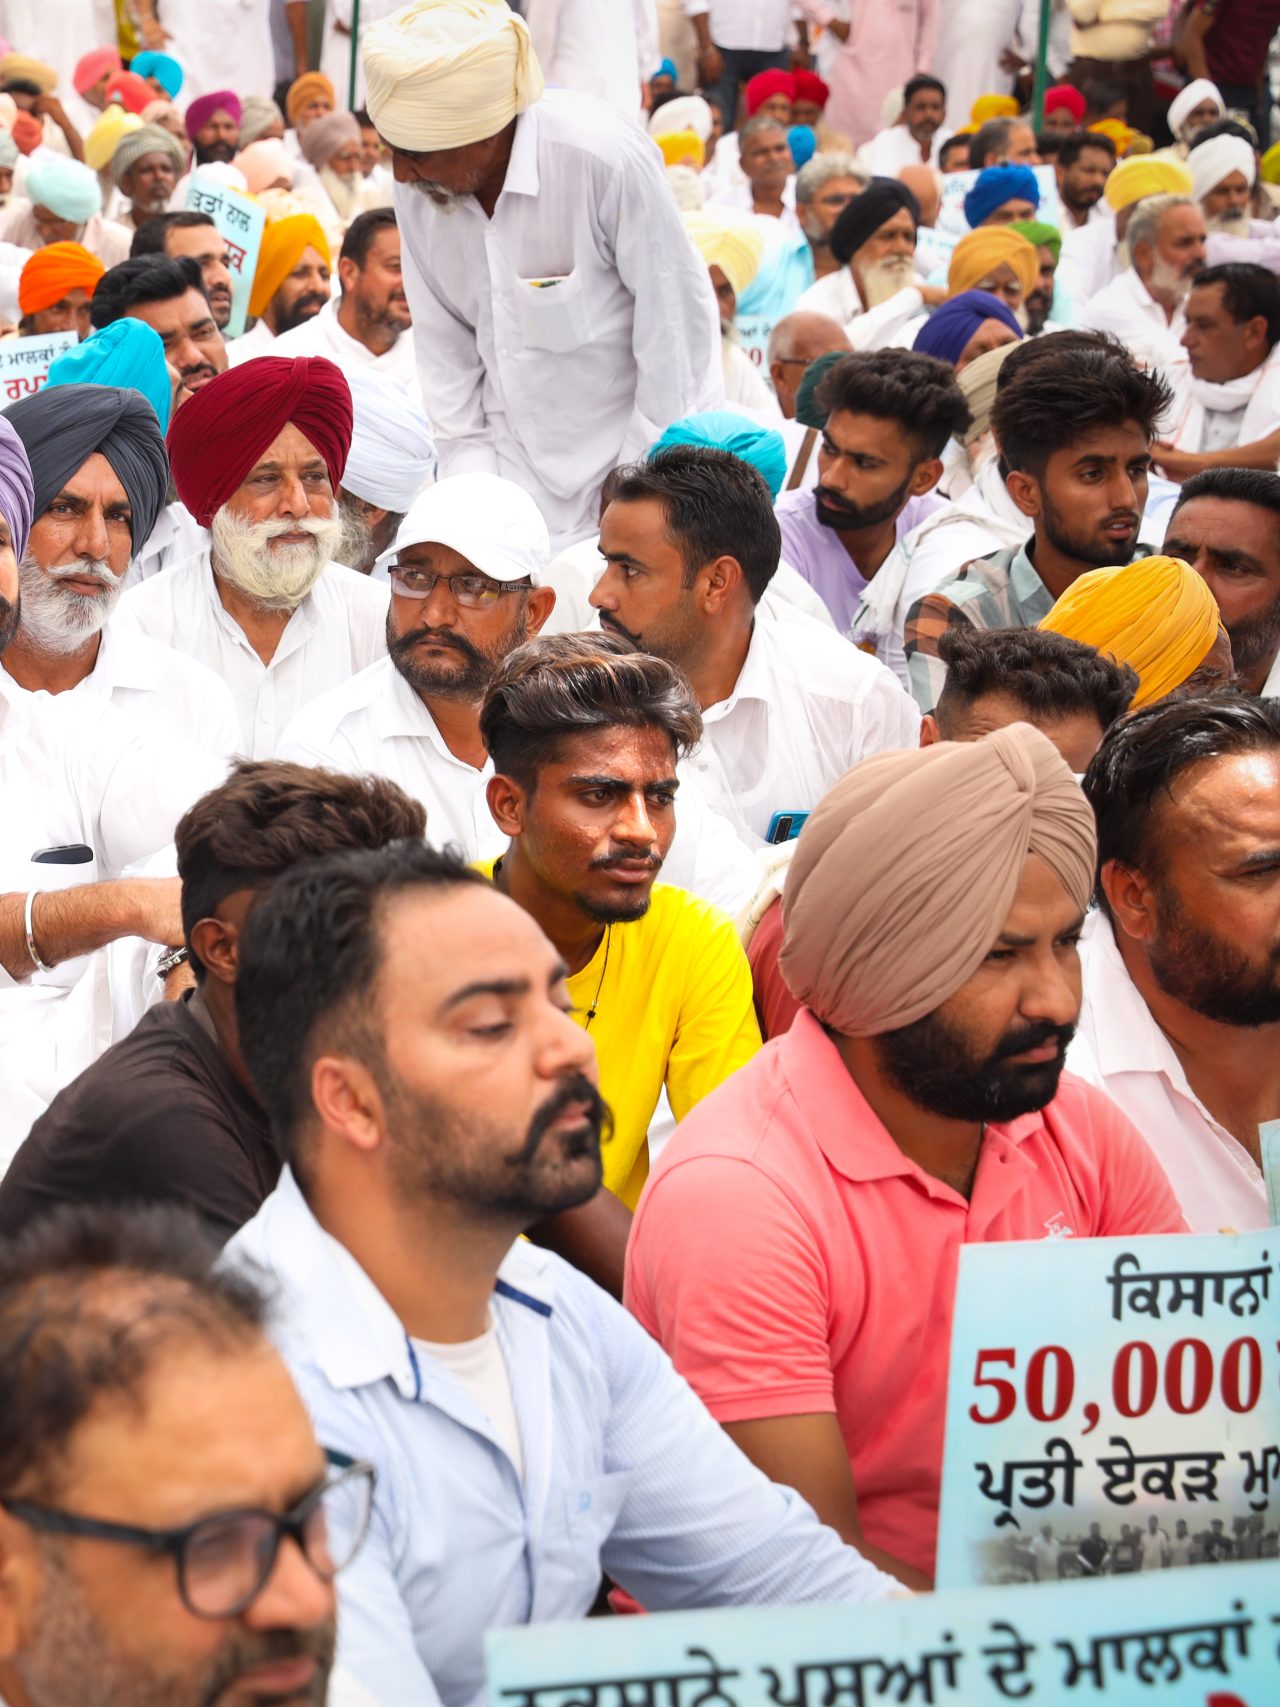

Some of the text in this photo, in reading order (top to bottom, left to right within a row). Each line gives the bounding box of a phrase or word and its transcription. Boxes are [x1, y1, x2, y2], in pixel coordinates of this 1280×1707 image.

[1106, 1250, 1274, 1322] ਕਿਸਾਨਾਂ
[968, 1336, 1263, 1436] 50,000
[974, 1436, 1084, 1530] ਪ੍ਰਤੀ
[1096, 1436, 1225, 1506] ਏਕੜ
[981, 1619, 1036, 1698] ਦੇ
[1053, 1599, 1254, 1690] ਮਾਲਕਾਂ
